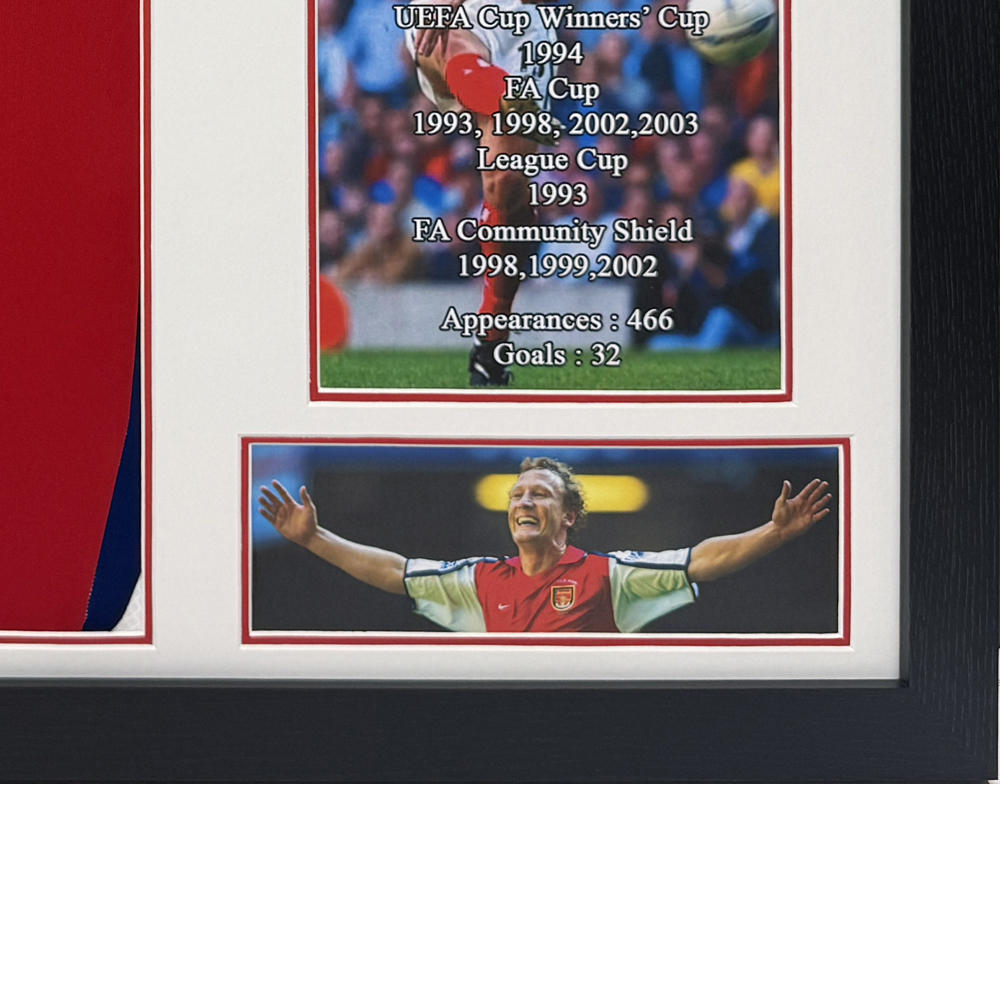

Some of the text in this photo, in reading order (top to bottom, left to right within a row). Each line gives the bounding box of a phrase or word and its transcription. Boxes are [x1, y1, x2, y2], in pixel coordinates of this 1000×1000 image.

[395, 6, 472, 28] UEFA
[479, 6, 530, 34] Cup
[658, 6, 709, 34] Cup
[523, 42, 583, 64] 1994
[505, 77, 600, 106] FA Cup
[415, 112, 698, 139] 1993, 1998, 2002,2003
[477, 148, 628, 177] League Cup
[529, 183, 587, 205] 1993
[413, 219, 693, 247] FA Community Shield
[459, 255, 657, 280] 1998,1999,2002
[441, 308, 602, 336] Appearances
[627, 308, 673, 330] 466
[493, 342, 566, 365] Goals
[592, 343, 620, 365] 32
